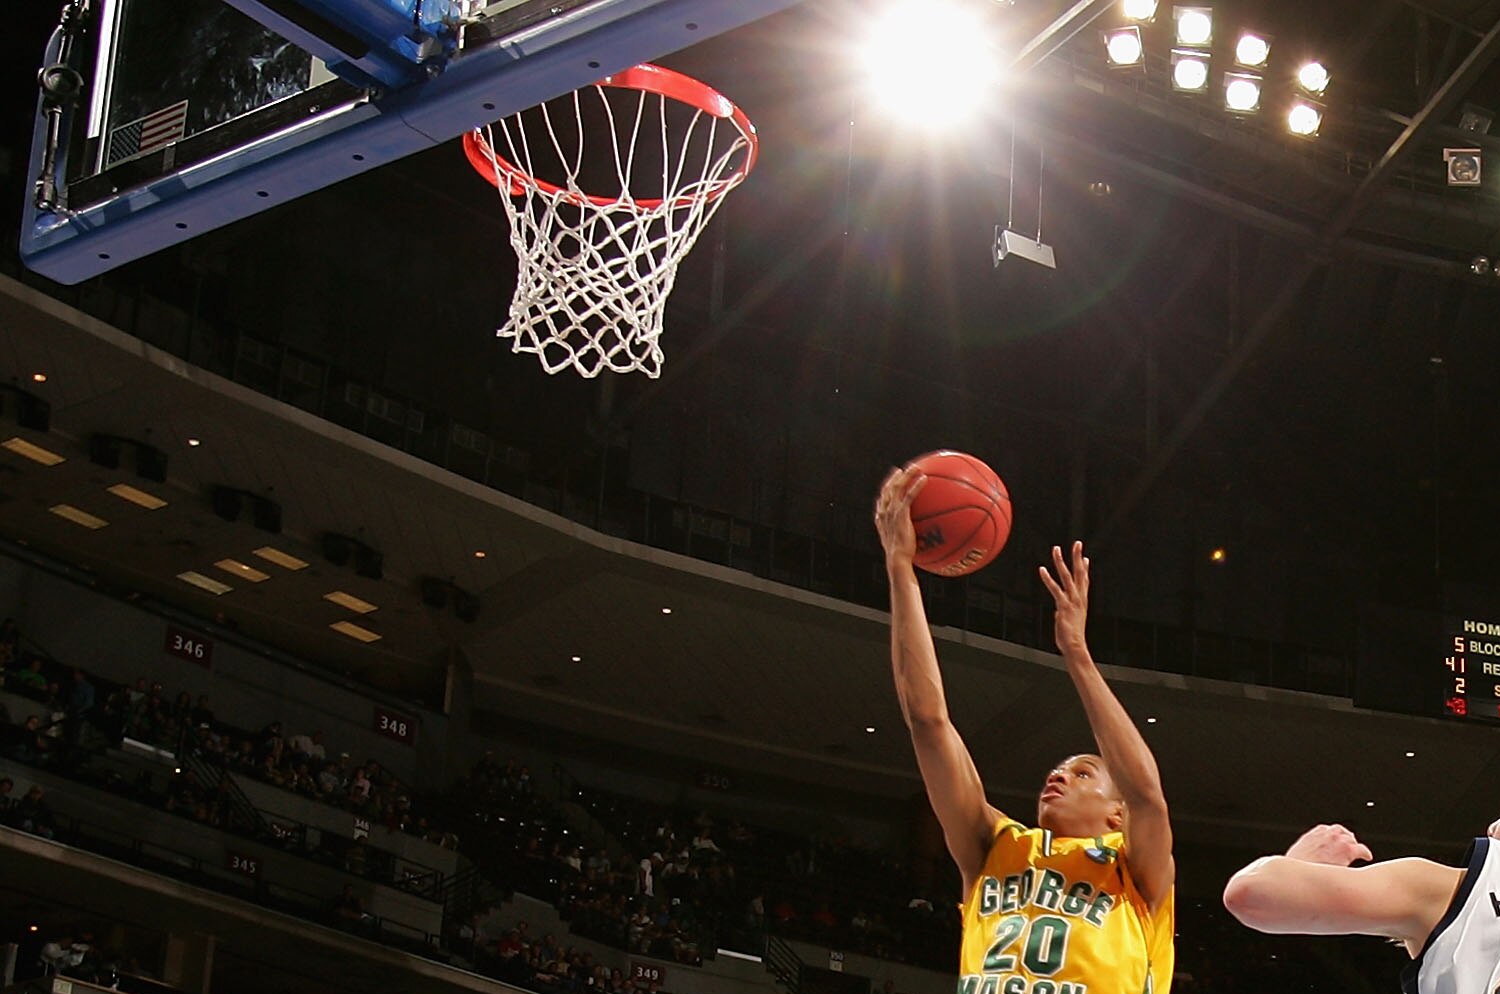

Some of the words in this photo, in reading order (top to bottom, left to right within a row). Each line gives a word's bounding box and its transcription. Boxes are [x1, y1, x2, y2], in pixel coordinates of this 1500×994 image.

[173, 634, 205, 660] 346
[1455, 637, 1465, 652] 5
[1445, 657, 1465, 673] 41
[1455, 678, 1465, 693] 2
[379, 715, 408, 737] 348
[232, 856, 257, 876] 345
[979, 867, 1116, 929] GEORGE
[983, 914, 1072, 977] 20
[636, 966, 659, 981] 349
